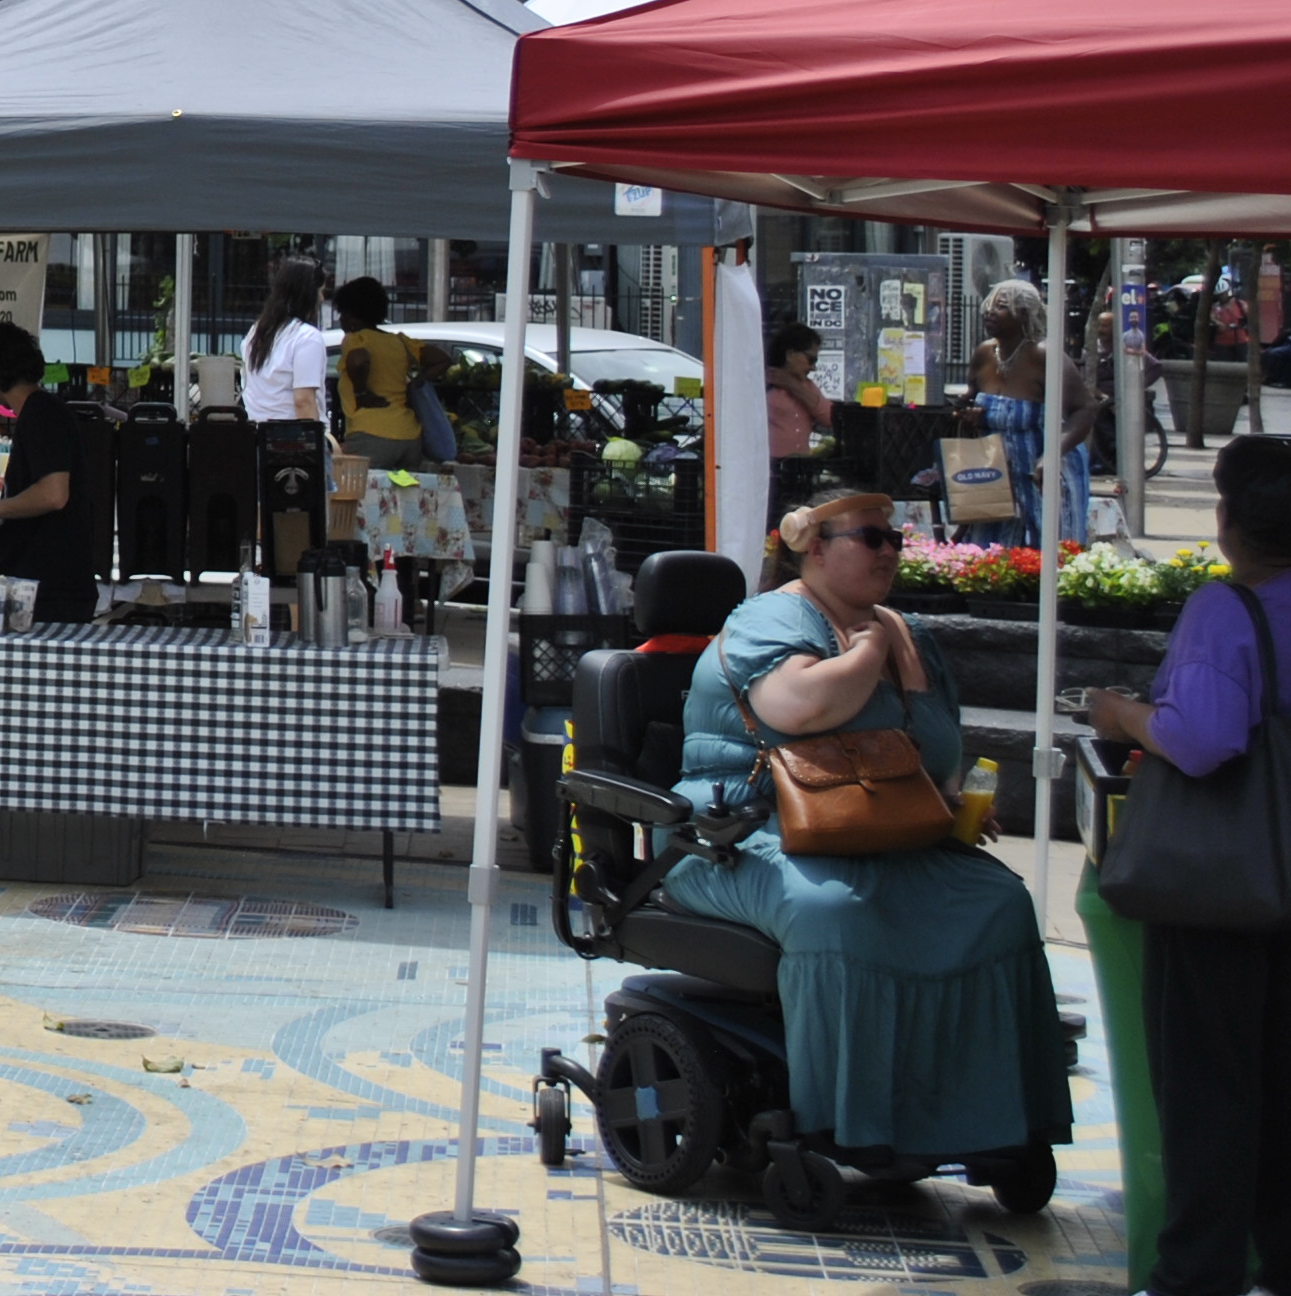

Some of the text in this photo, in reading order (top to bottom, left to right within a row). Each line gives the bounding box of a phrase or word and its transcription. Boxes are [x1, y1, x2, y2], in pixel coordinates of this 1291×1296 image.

[810, 288, 842, 300] NO
[810, 301, 842, 312] ICE
[810, 320, 842, 328] IN DC
[974, 471, 997, 480] NAVY
